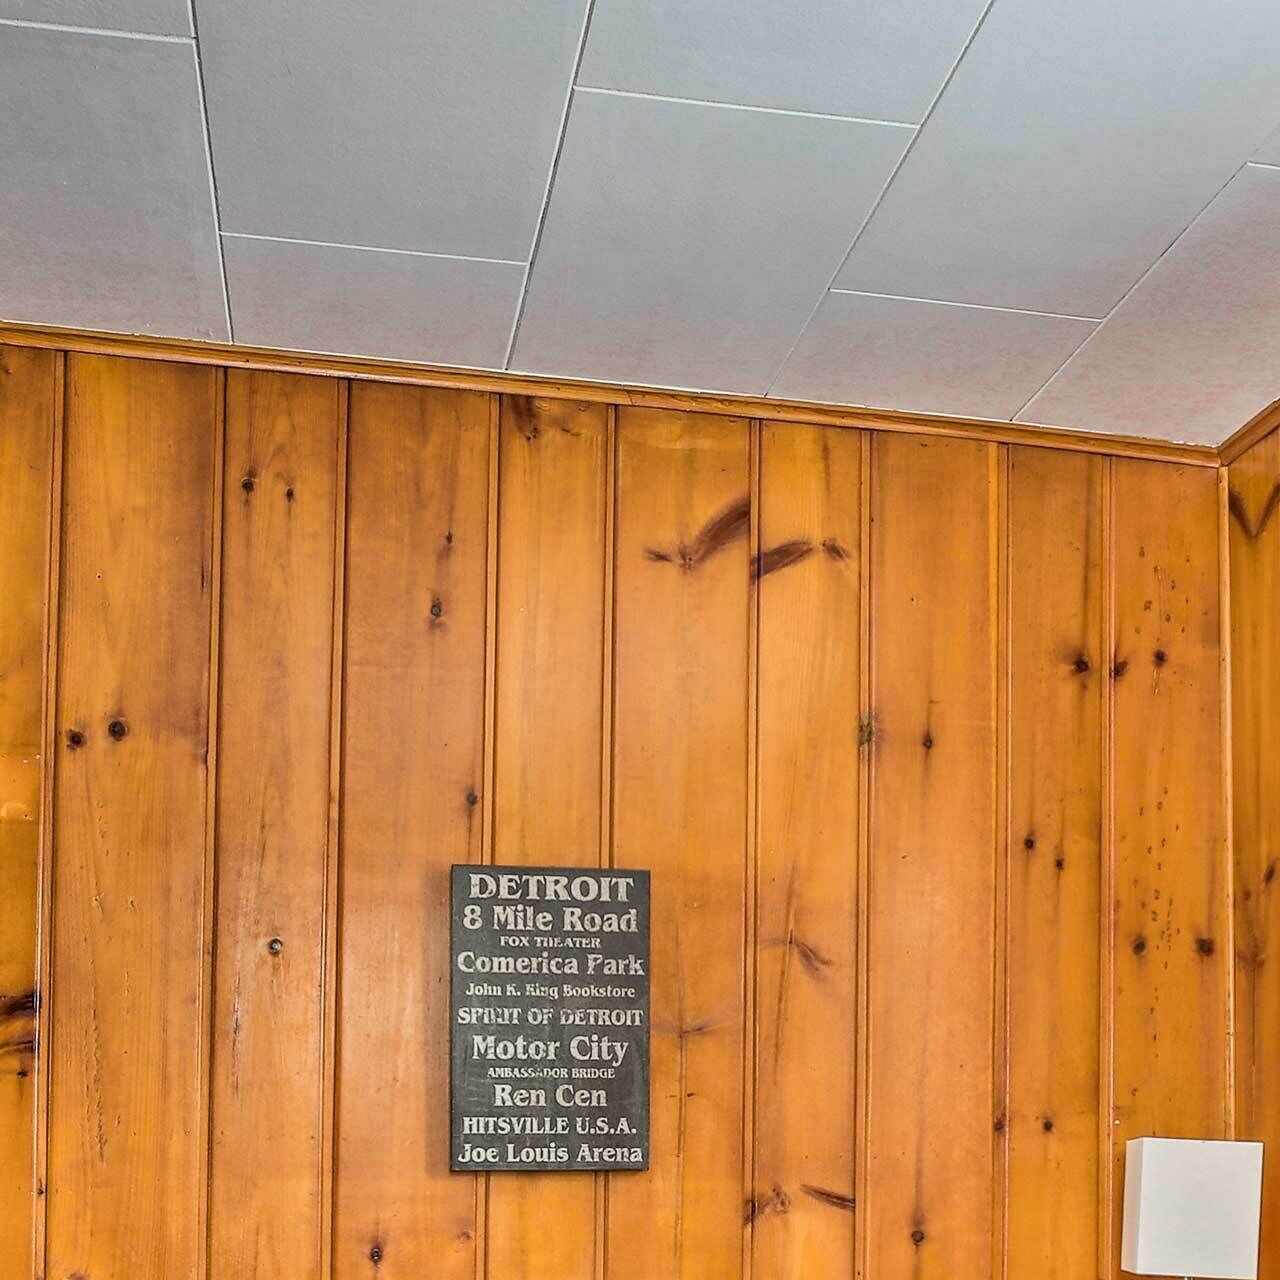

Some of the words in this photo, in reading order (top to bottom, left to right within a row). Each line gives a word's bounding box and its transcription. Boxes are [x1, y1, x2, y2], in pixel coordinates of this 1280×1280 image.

[469, 873, 634, 902] DETROIT
[462, 904, 483, 930] 8
[493, 904, 554, 931] Mile
[562, 907, 639, 932] Road
[500, 936, 530, 947] FOX
[534, 936, 601, 948] THEATER
[457, 951, 579, 974] Comerica
[587, 953, 645, 976] Park
[465, 983, 502, 996] John
[506, 984, 521, 996] K.
[525, 983, 559, 1000] King
[562, 984, 636, 998] Bookstore
[457, 1007, 521, 1025] SPIRIT
[527, 1007, 554, 1025] OF
[559, 1008, 644, 1026] DETROIT
[472, 1034, 560, 1060] Motor
[569, 1033, 629, 1067] City
[487, 1067, 568, 1078] AMBASSADOR
[572, 1068, 616, 1079] BRIDGE
[493, 1084, 546, 1107] Ren
[555, 1084, 608, 1107] Cen
[462, 1116, 569, 1135] HITSVILLE
[575, 1117, 637, 1135] U.S.A.
[457, 1143, 500, 1163] Joe
[506, 1142, 569, 1163] Louis
[576, 1143, 643, 1162] Arena
